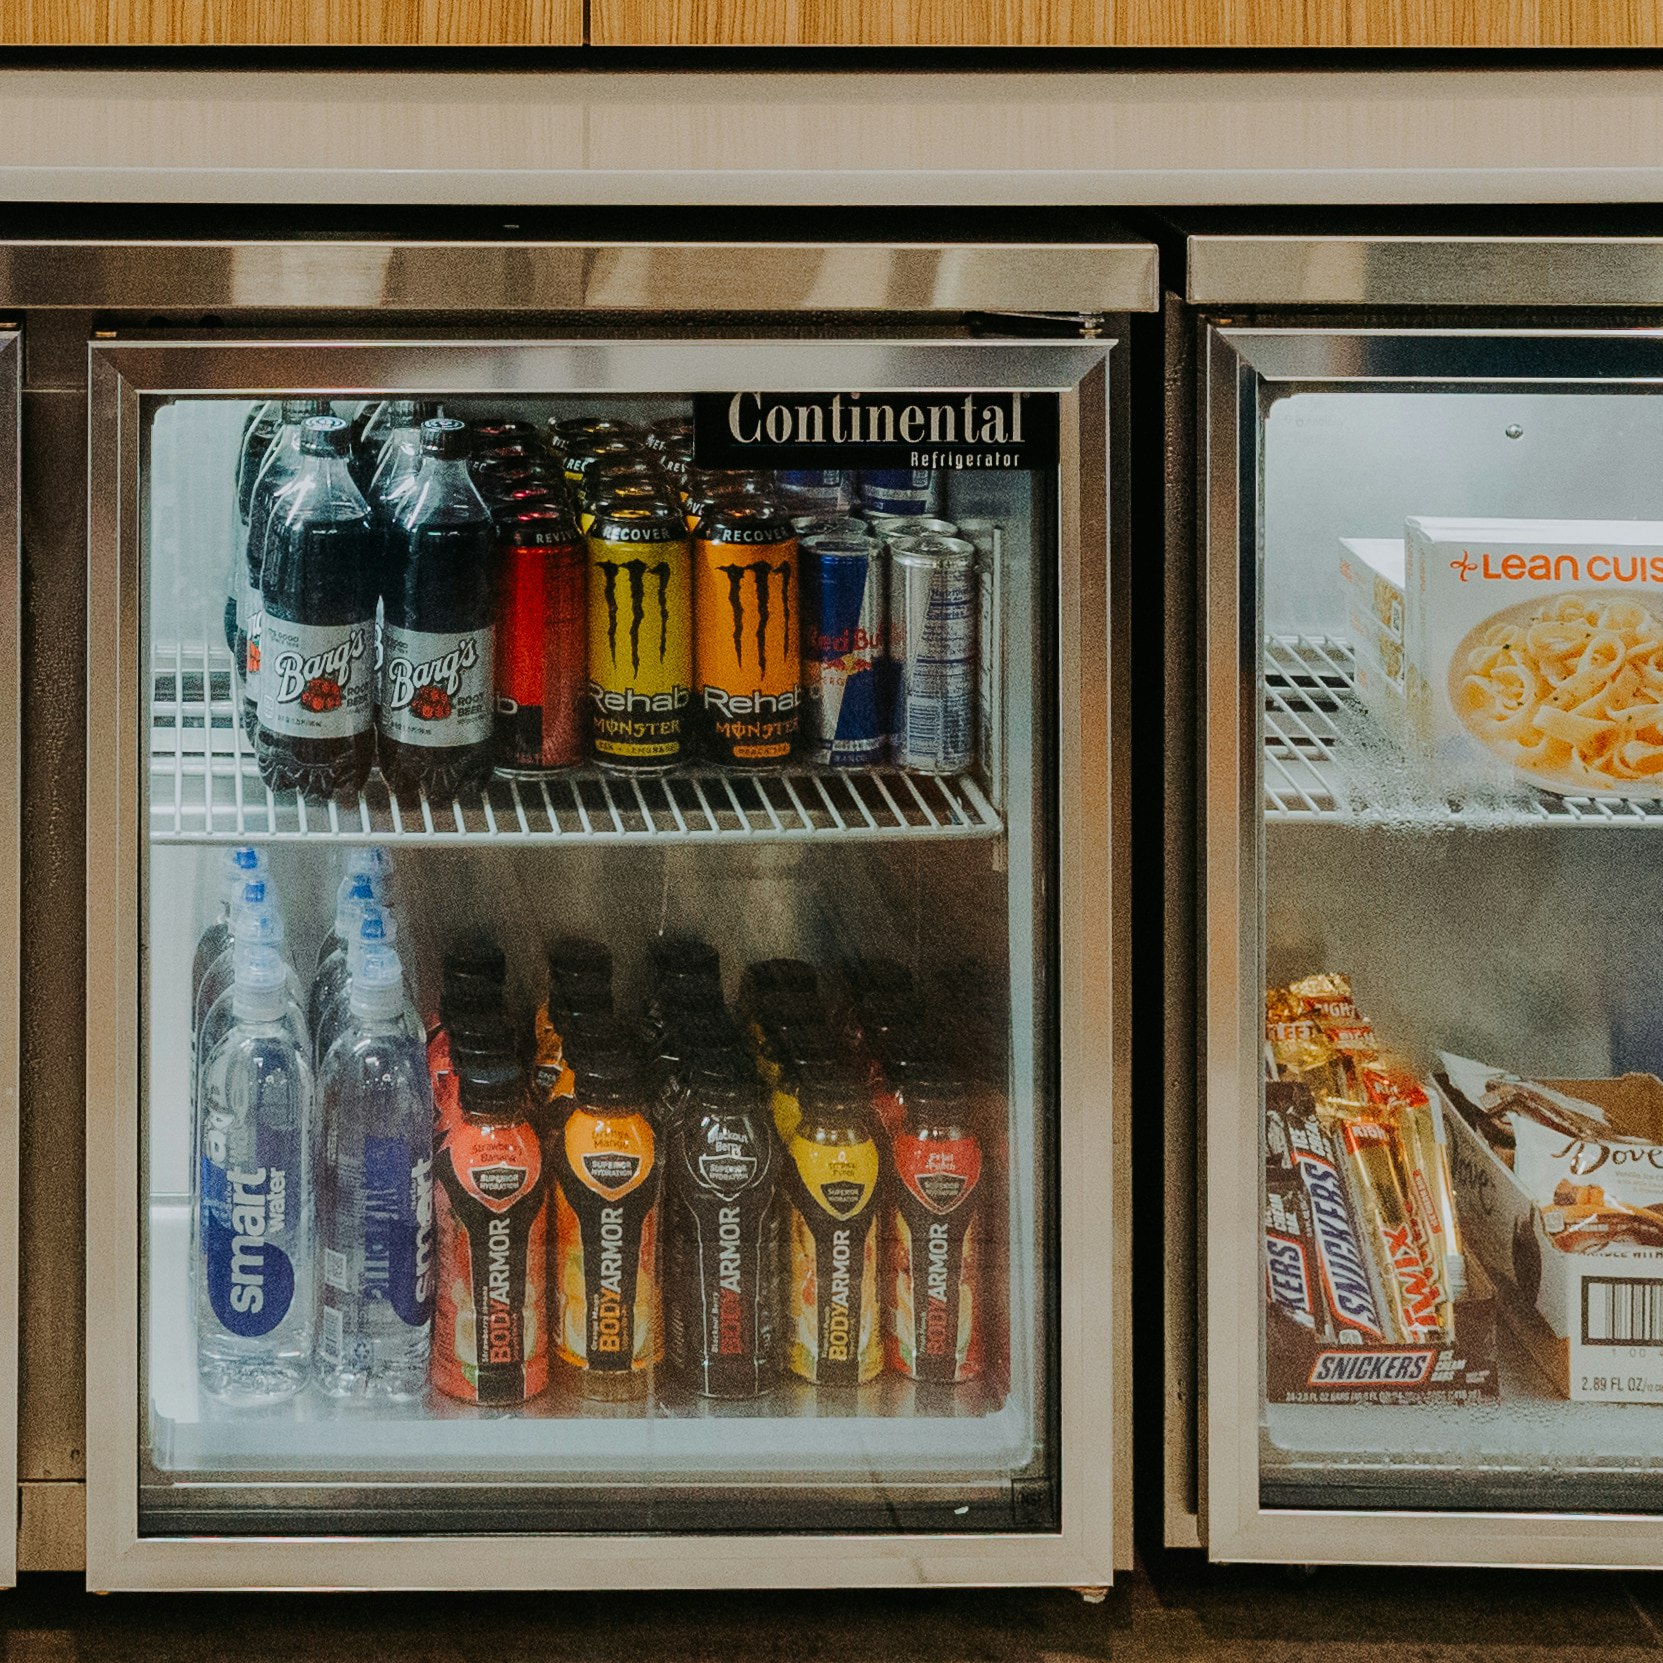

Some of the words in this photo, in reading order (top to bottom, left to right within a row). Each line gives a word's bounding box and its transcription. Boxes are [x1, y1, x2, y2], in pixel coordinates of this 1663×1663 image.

[729, 391, 1025, 443] Continental
[911, 451, 1020, 469] Refrigerator
[603, 526, 671, 541] RECOVER
[723, 527, 787, 542] RECOVER
[274, 627, 365, 705] Barq's
[389, 638, 478, 709] Barq's
[591, 1160, 632, 1169] SUPERIOR
[591, 1169, 633, 1177] HYDRATION
[267, 1167, 287, 1234] water
[229, 1167, 266, 1315] smart
[489, 1218, 511, 1365] BODYARMOR
[600, 1207, 624, 1353] BODYARMOR
[719, 1206, 743, 1355] BODYARMOR
[828, 1229, 850, 1362] BODYARMOR
[926, 1223, 949, 1356] BODYARMOR
[1317, 1355, 1428, 1381] SNICKERS
[1582, 1377, 1607, 1391] 2.89
[1610, 1377, 1623, 1390] FL
